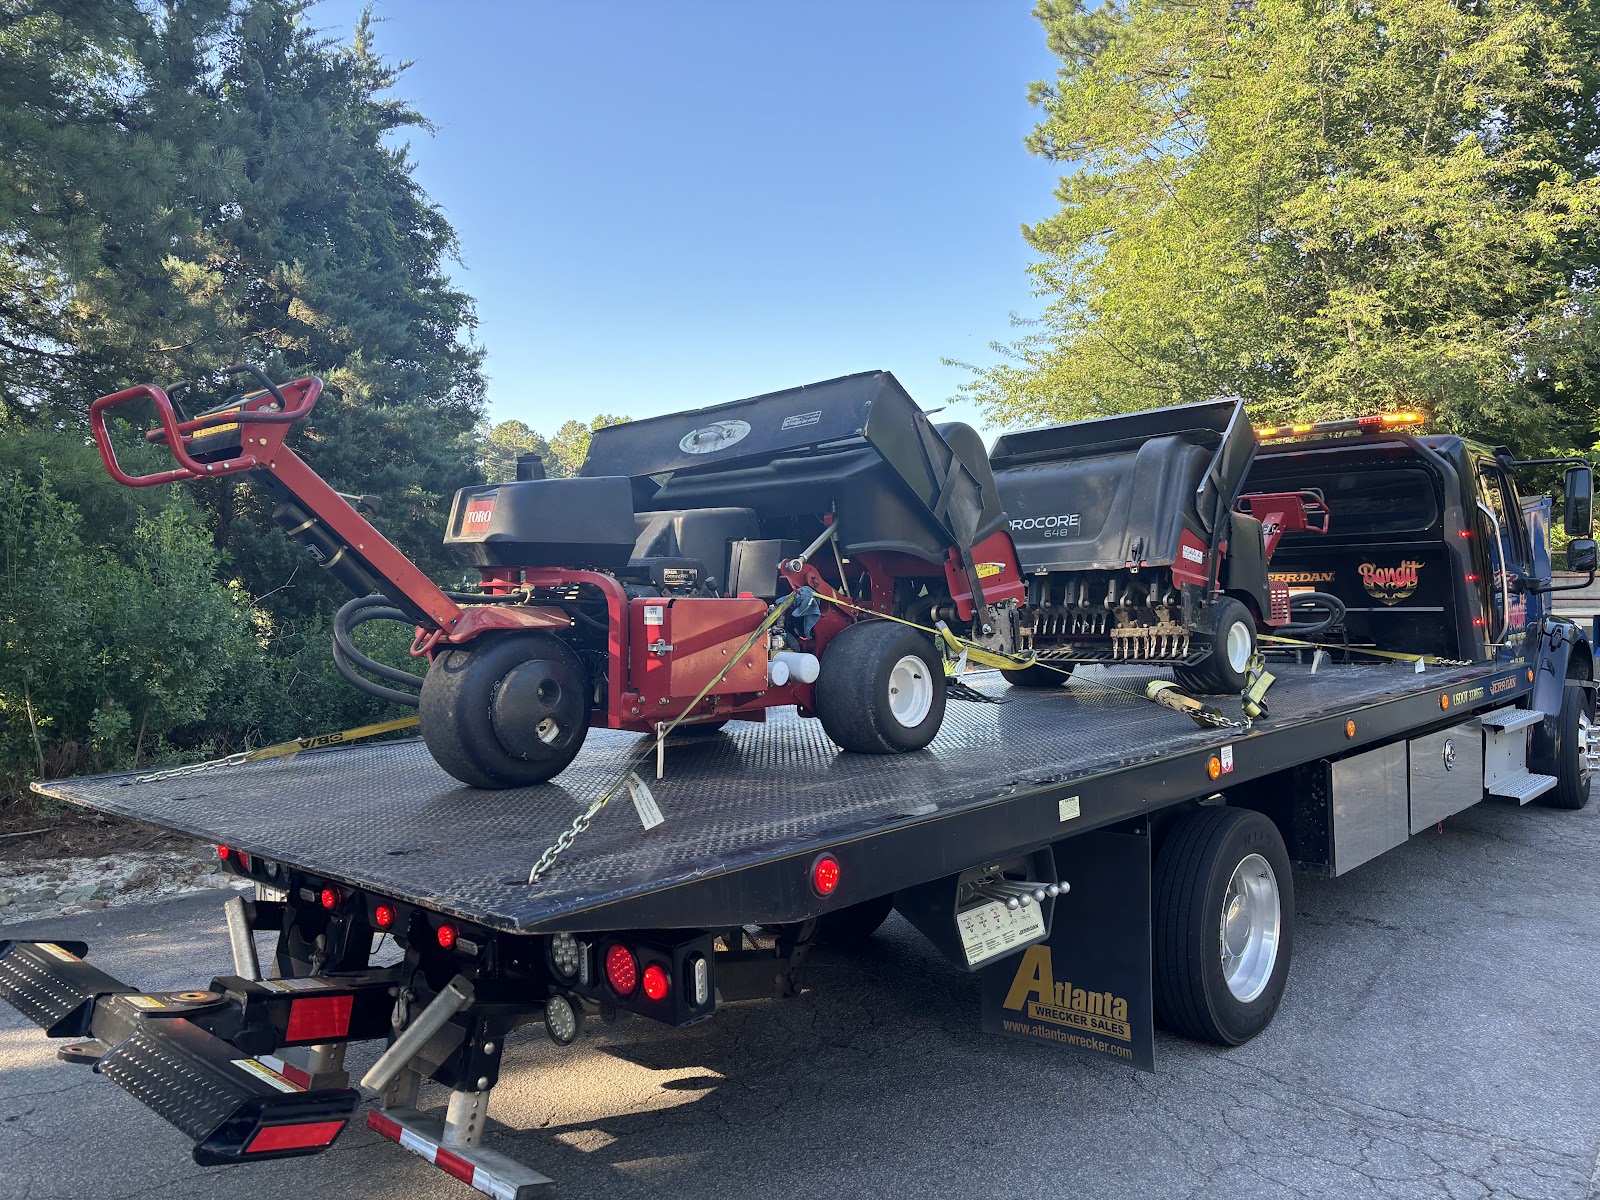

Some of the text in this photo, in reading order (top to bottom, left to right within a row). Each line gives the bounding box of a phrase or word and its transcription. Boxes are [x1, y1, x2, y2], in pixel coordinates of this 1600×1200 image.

[467, 510, 492, 523] TORO
[1044, 528, 1068, 537] 648
[1358, 560, 1425, 588] Bandit
[1003, 944, 1128, 1023] Atlanta
[1035, 1006, 1125, 1035] WRECKER SALES
[1003, 1020, 1133, 1060] www.atlantawrecker.com
